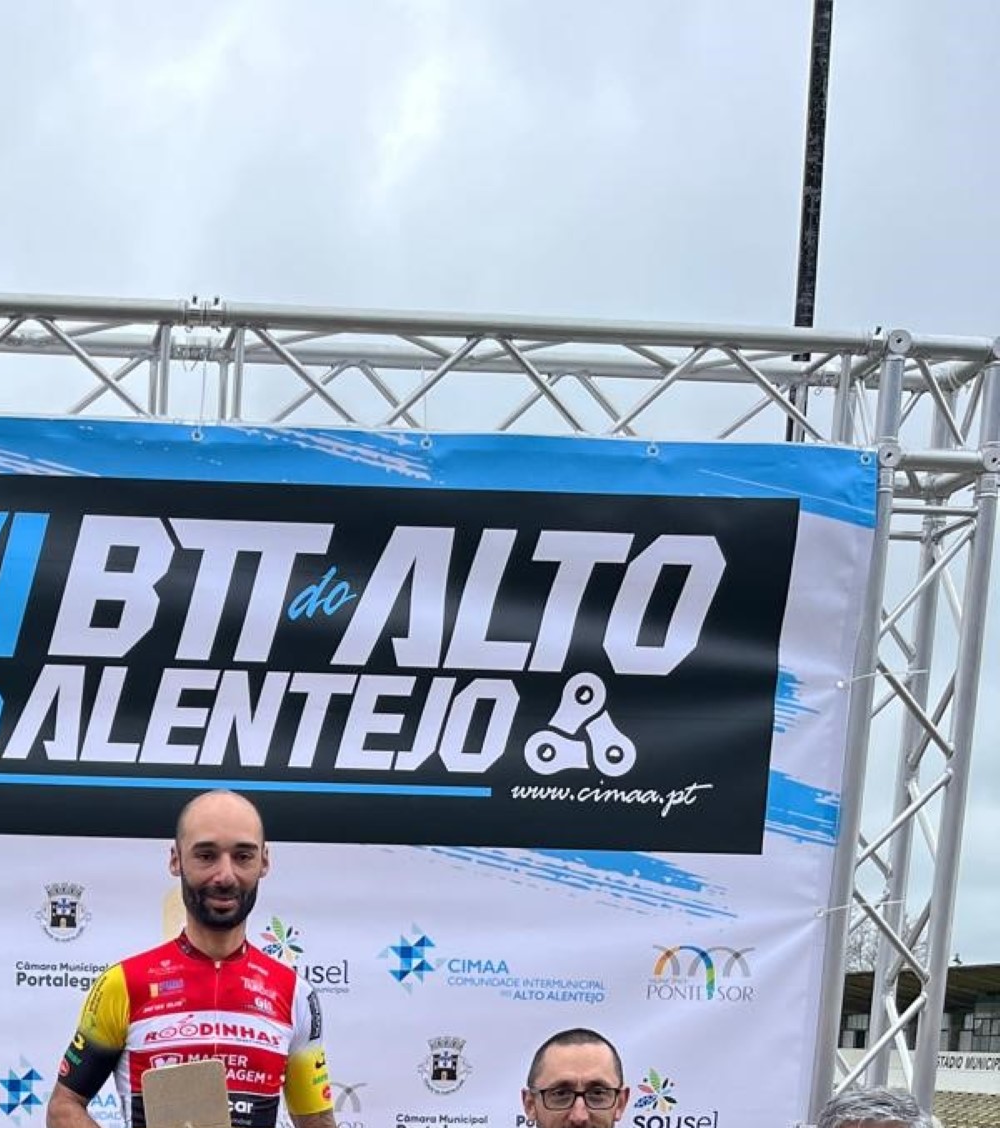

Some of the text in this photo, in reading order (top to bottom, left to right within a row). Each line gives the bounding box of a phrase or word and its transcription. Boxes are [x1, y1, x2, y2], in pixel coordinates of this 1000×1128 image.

[47, 514, 335, 662] BTT
[287, 565, 357, 621] do
[330, 525, 727, 675] ALTO
[1, 664, 520, 773] ALENTEJO
[511, 782, 713, 816] www.cimaa.pt
[448, 959, 509, 974] CIMAA
[513, 990, 544, 1001] ALTO
[548, 991, 606, 1004] ALENTEJO
[718, 985, 755, 1001] SOR
[396, 1114, 488, 1125] Câmara Municipal
